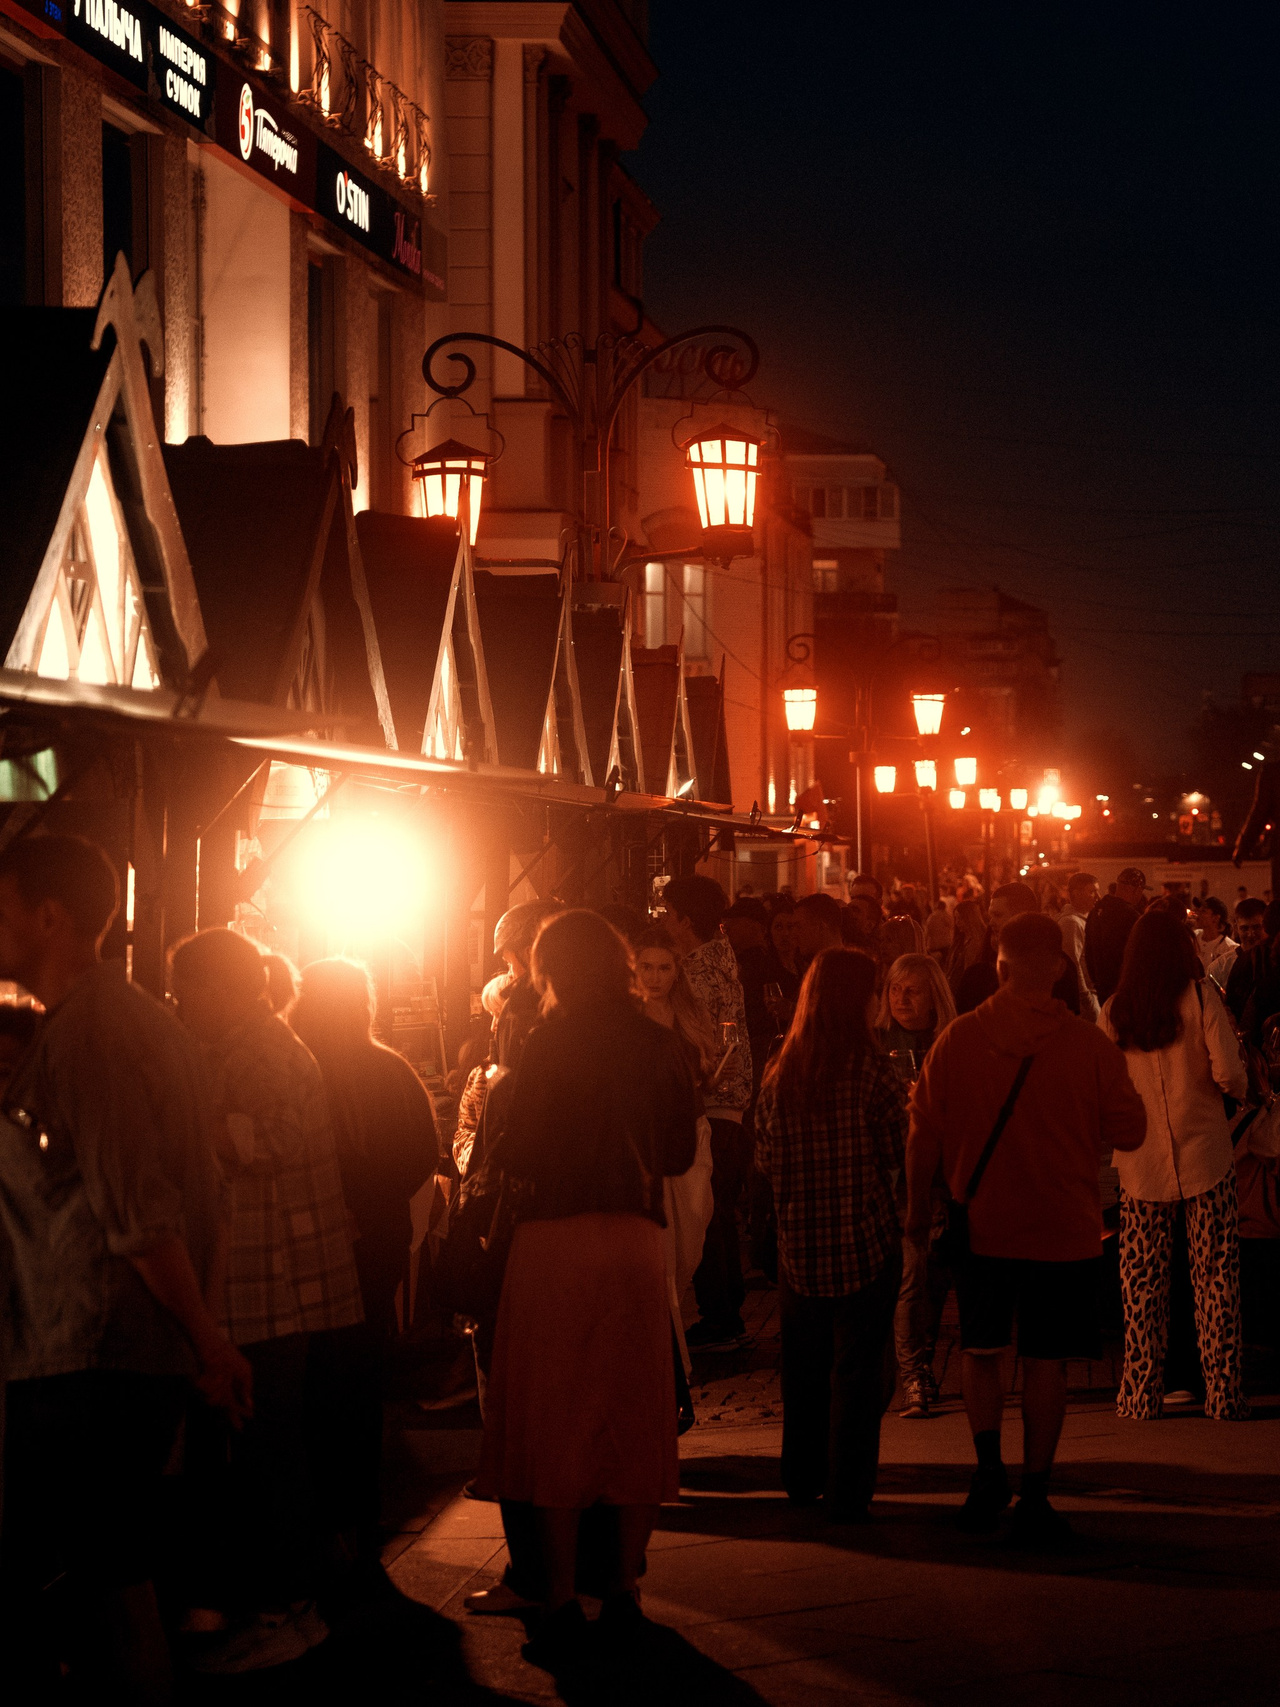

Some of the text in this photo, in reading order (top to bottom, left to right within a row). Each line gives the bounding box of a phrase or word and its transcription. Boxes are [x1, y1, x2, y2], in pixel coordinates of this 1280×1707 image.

[159, 25, 207, 86] ИМПЕРИЯ
[166, 68, 201, 118] СУМОК
[336, 170, 370, 233] O'STIN
